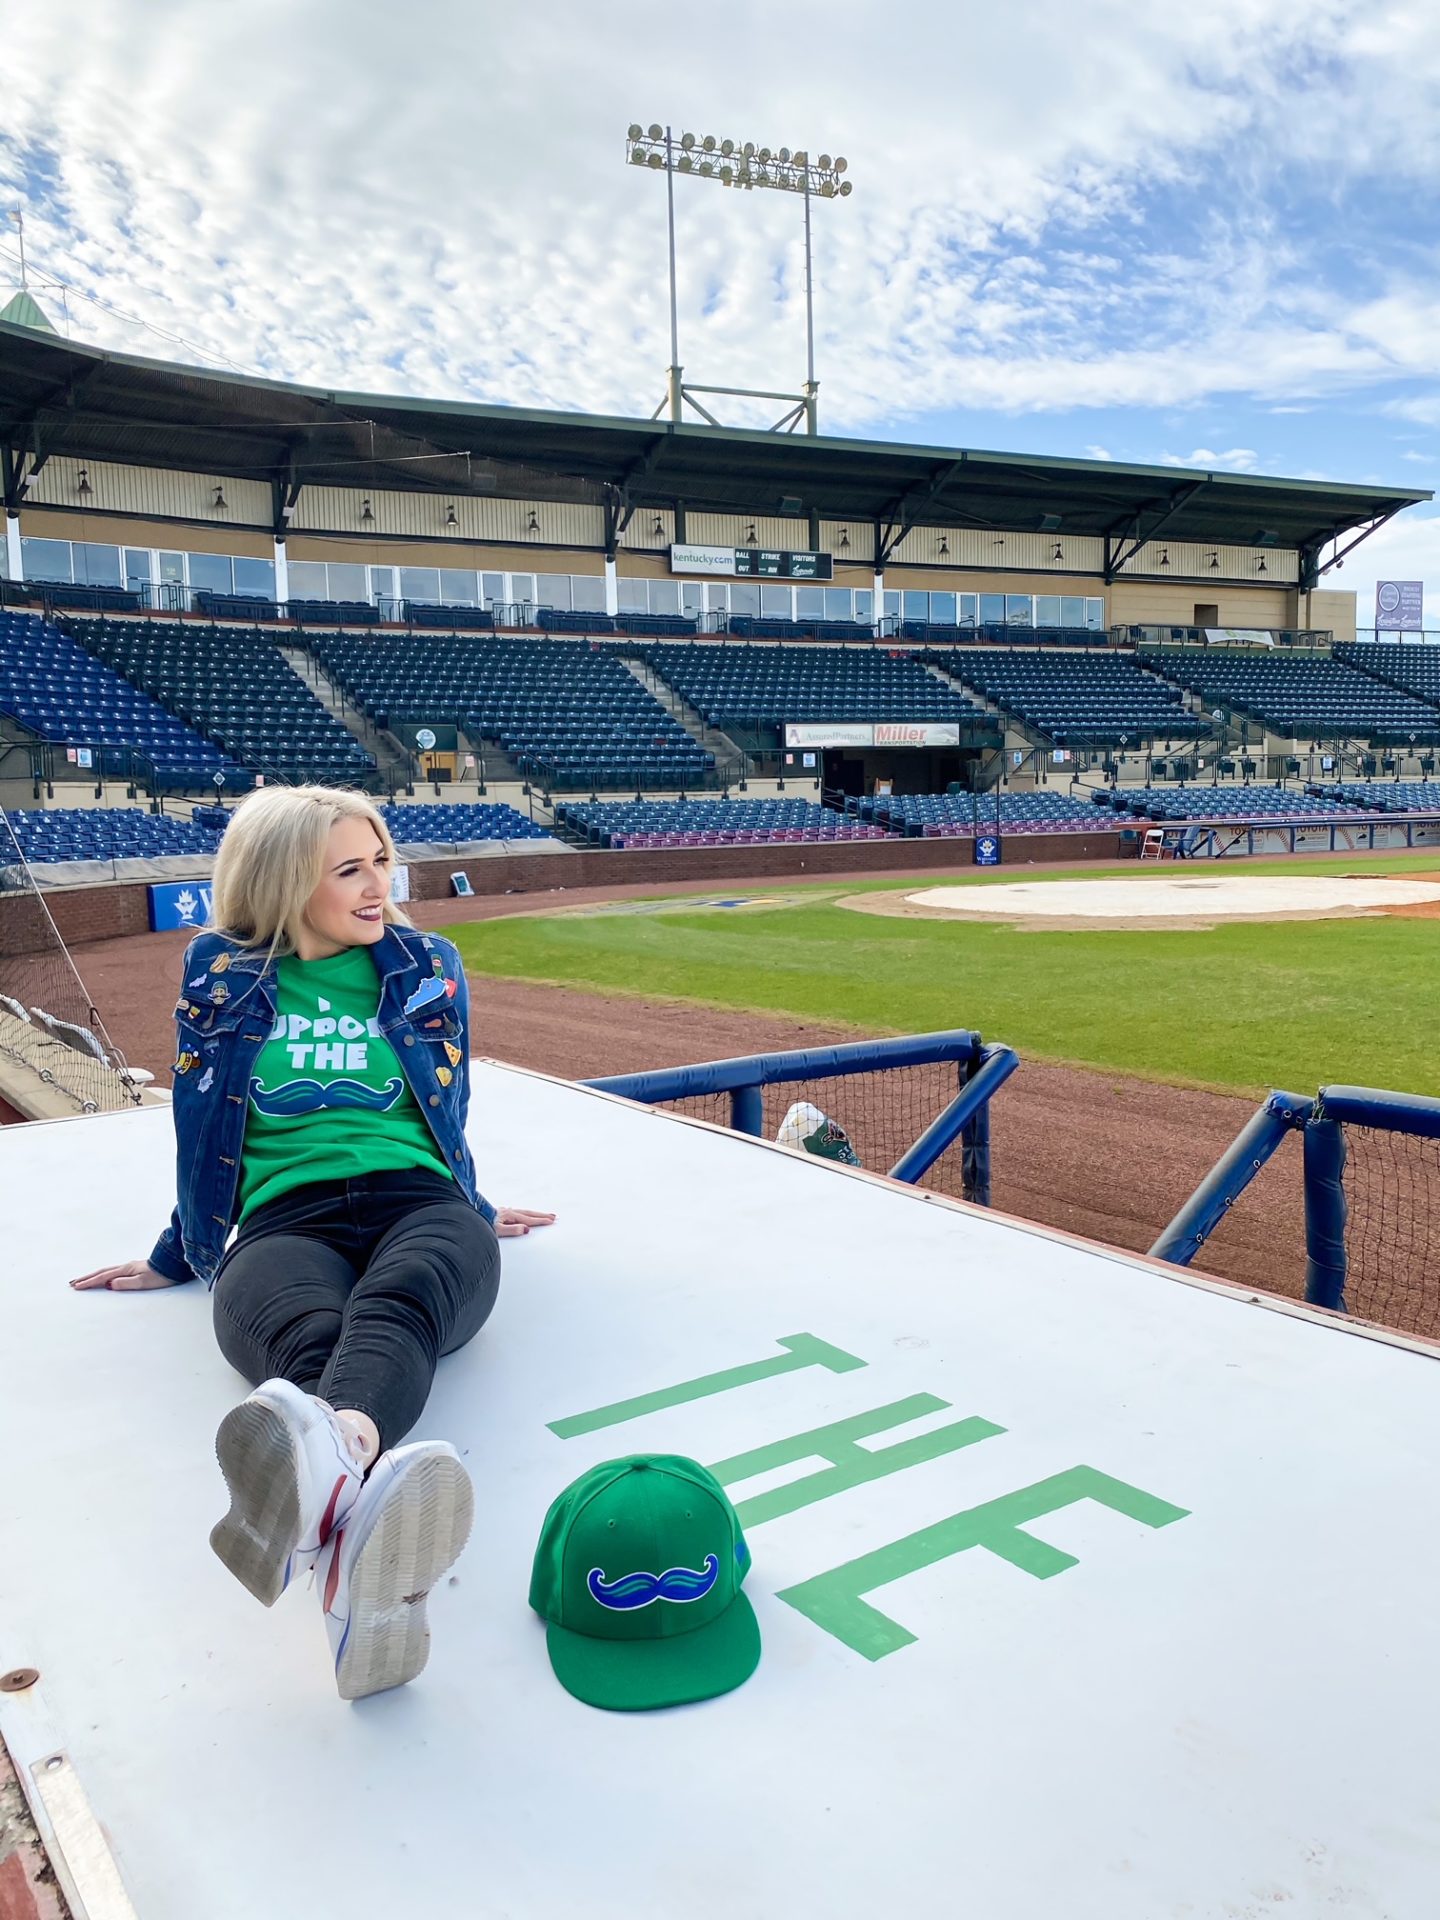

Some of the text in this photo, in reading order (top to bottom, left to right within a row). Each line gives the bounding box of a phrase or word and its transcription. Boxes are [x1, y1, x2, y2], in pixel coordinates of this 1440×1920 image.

[673, 550, 733, 566] kentucky.com
[735, 550, 750, 559] BALL
[761, 552, 780, 561] STRIKE
[792, 554, 816, 563] VISITORS
[738, 564, 750, 573] OUT
[876, 725, 928, 741] Miller
[285, 1042, 368, 1071] THE
